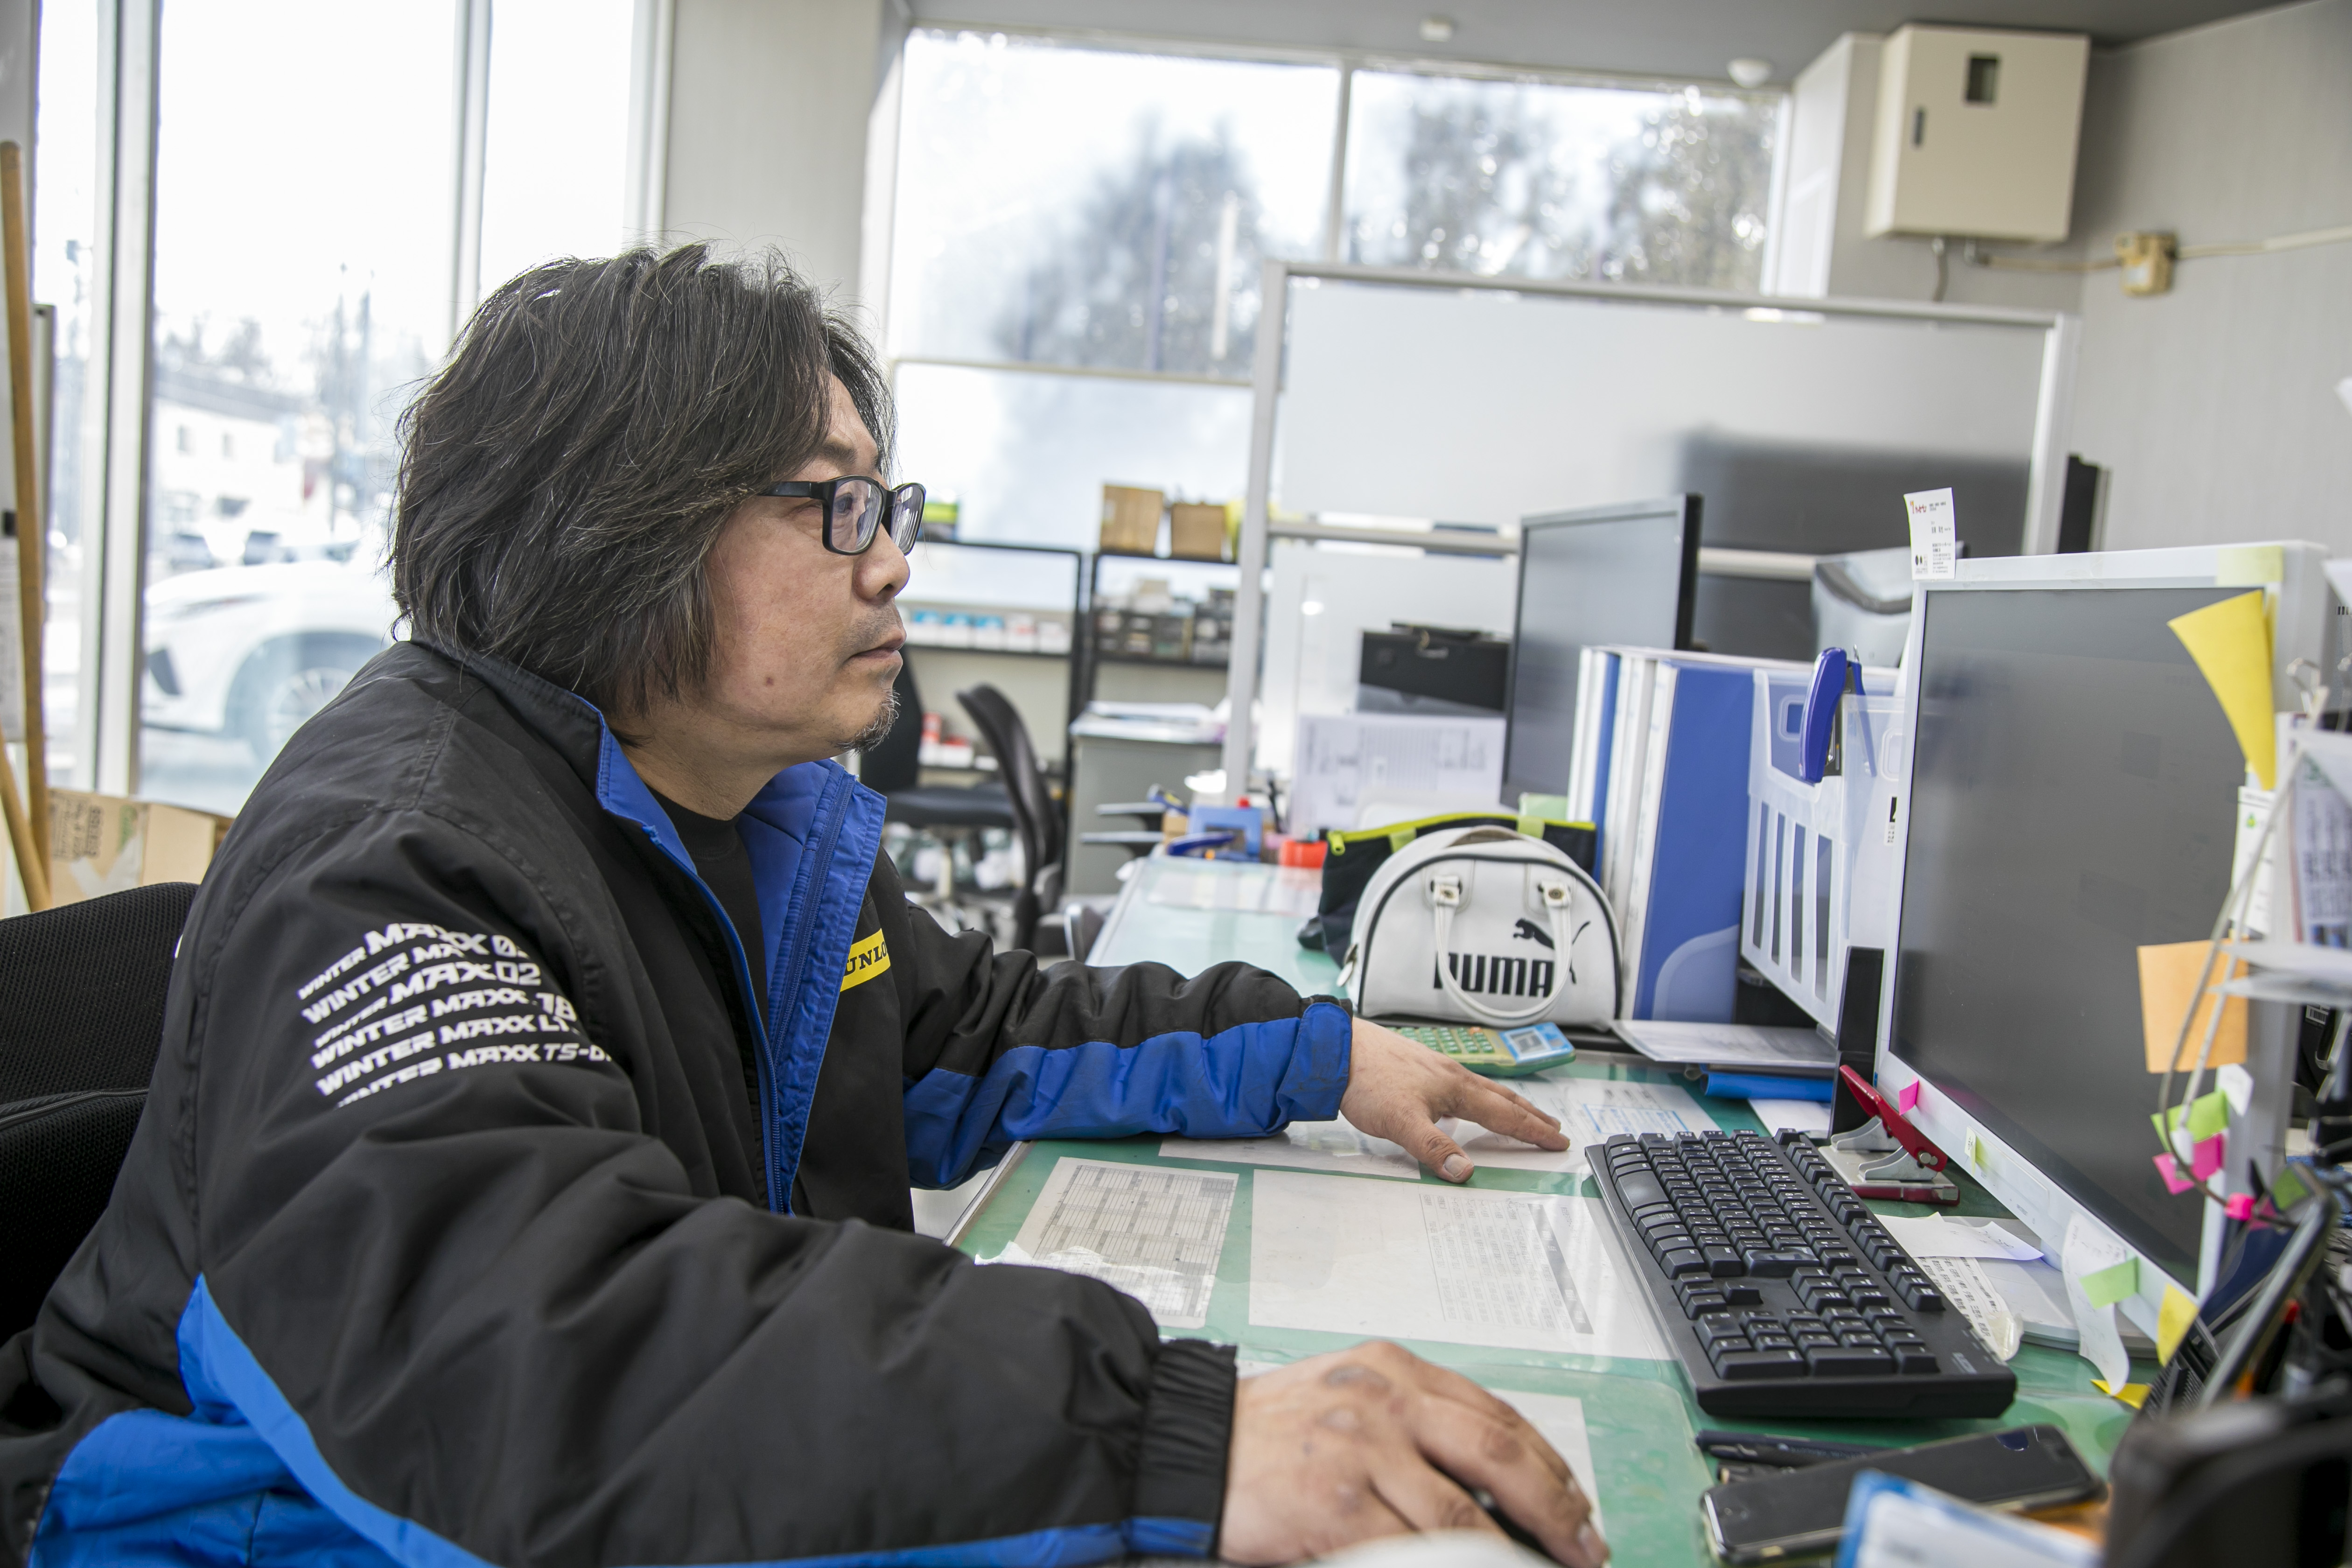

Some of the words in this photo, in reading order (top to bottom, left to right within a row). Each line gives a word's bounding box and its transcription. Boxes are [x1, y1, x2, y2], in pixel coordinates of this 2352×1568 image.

[297, 946, 368, 1000] WINTER
[491, 935, 530, 959] 0
[301, 952, 411, 1024] WINTER
[1434, 951, 1554, 998] PUMA
[310, 1004, 428, 1070] WINTER
[431, 987, 530, 1018] MAXX
[314, 996, 388, 1049] WINTER
[495, 961, 542, 986] 02
[315, 1031, 436, 1097] WINTER
[439, 1014, 537, 1044] MAXX
[448, 1043, 541, 1071] MAXX
